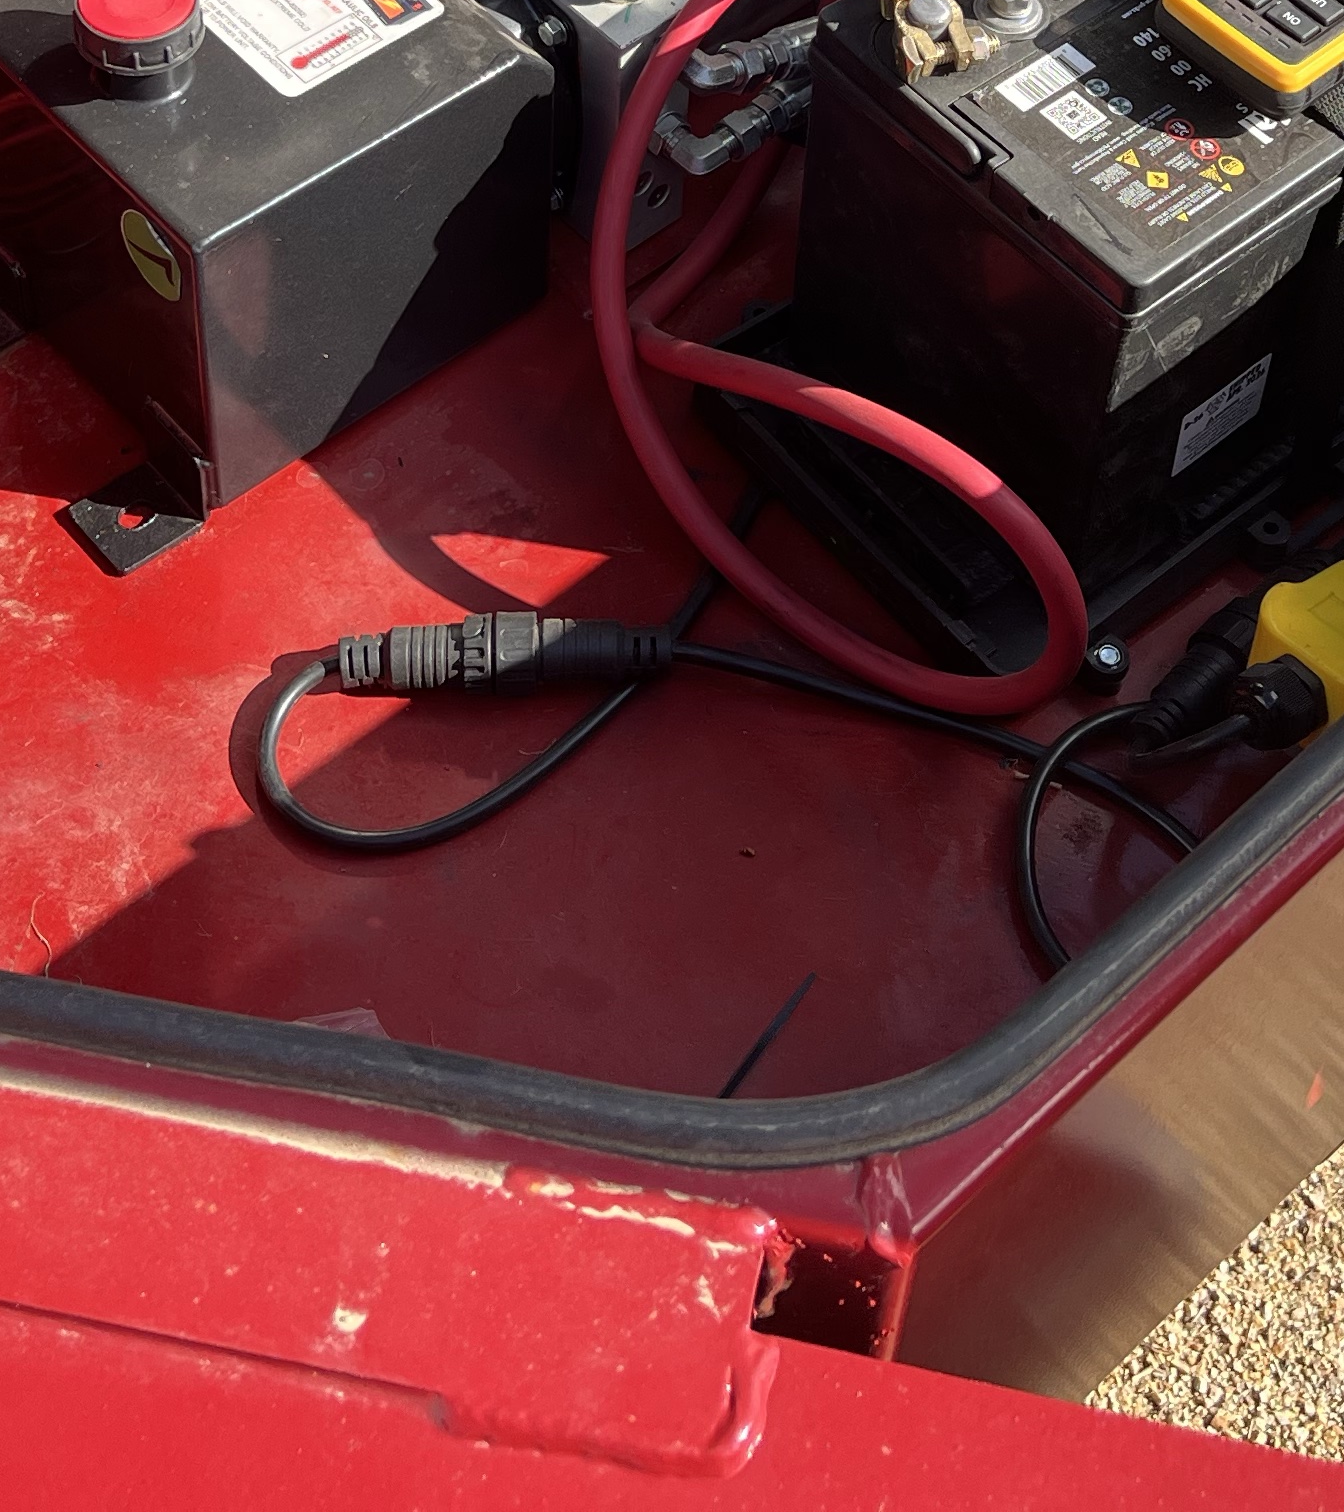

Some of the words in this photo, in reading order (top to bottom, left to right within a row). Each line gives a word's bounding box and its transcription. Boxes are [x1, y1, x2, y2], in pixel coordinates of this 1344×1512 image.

[360, 14, 379, 29] OILS
[1282, 11, 1301, 25] ON
[1132, 27, 1160, 47] 140
[1151, 44, 1172, 61] 60
